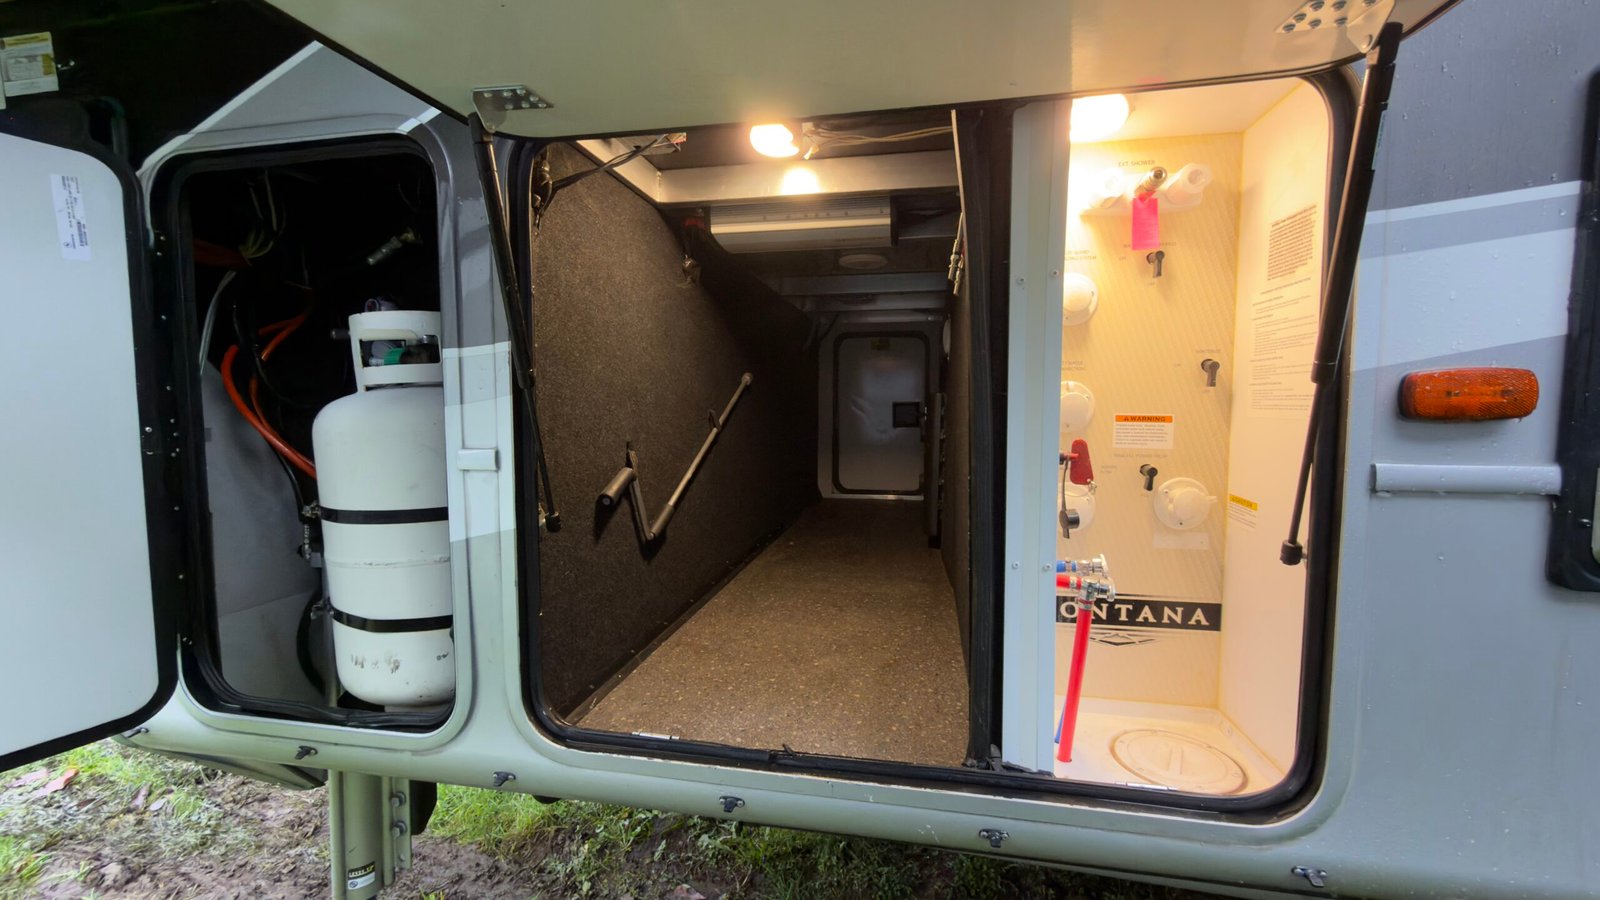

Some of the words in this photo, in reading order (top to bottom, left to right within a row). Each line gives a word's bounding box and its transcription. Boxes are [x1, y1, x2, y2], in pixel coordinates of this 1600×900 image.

[1131, 159, 1156, 167] SHOWER
[1130, 415, 1166, 423] WARNING
[1059, 601, 1210, 626] ONTANA
